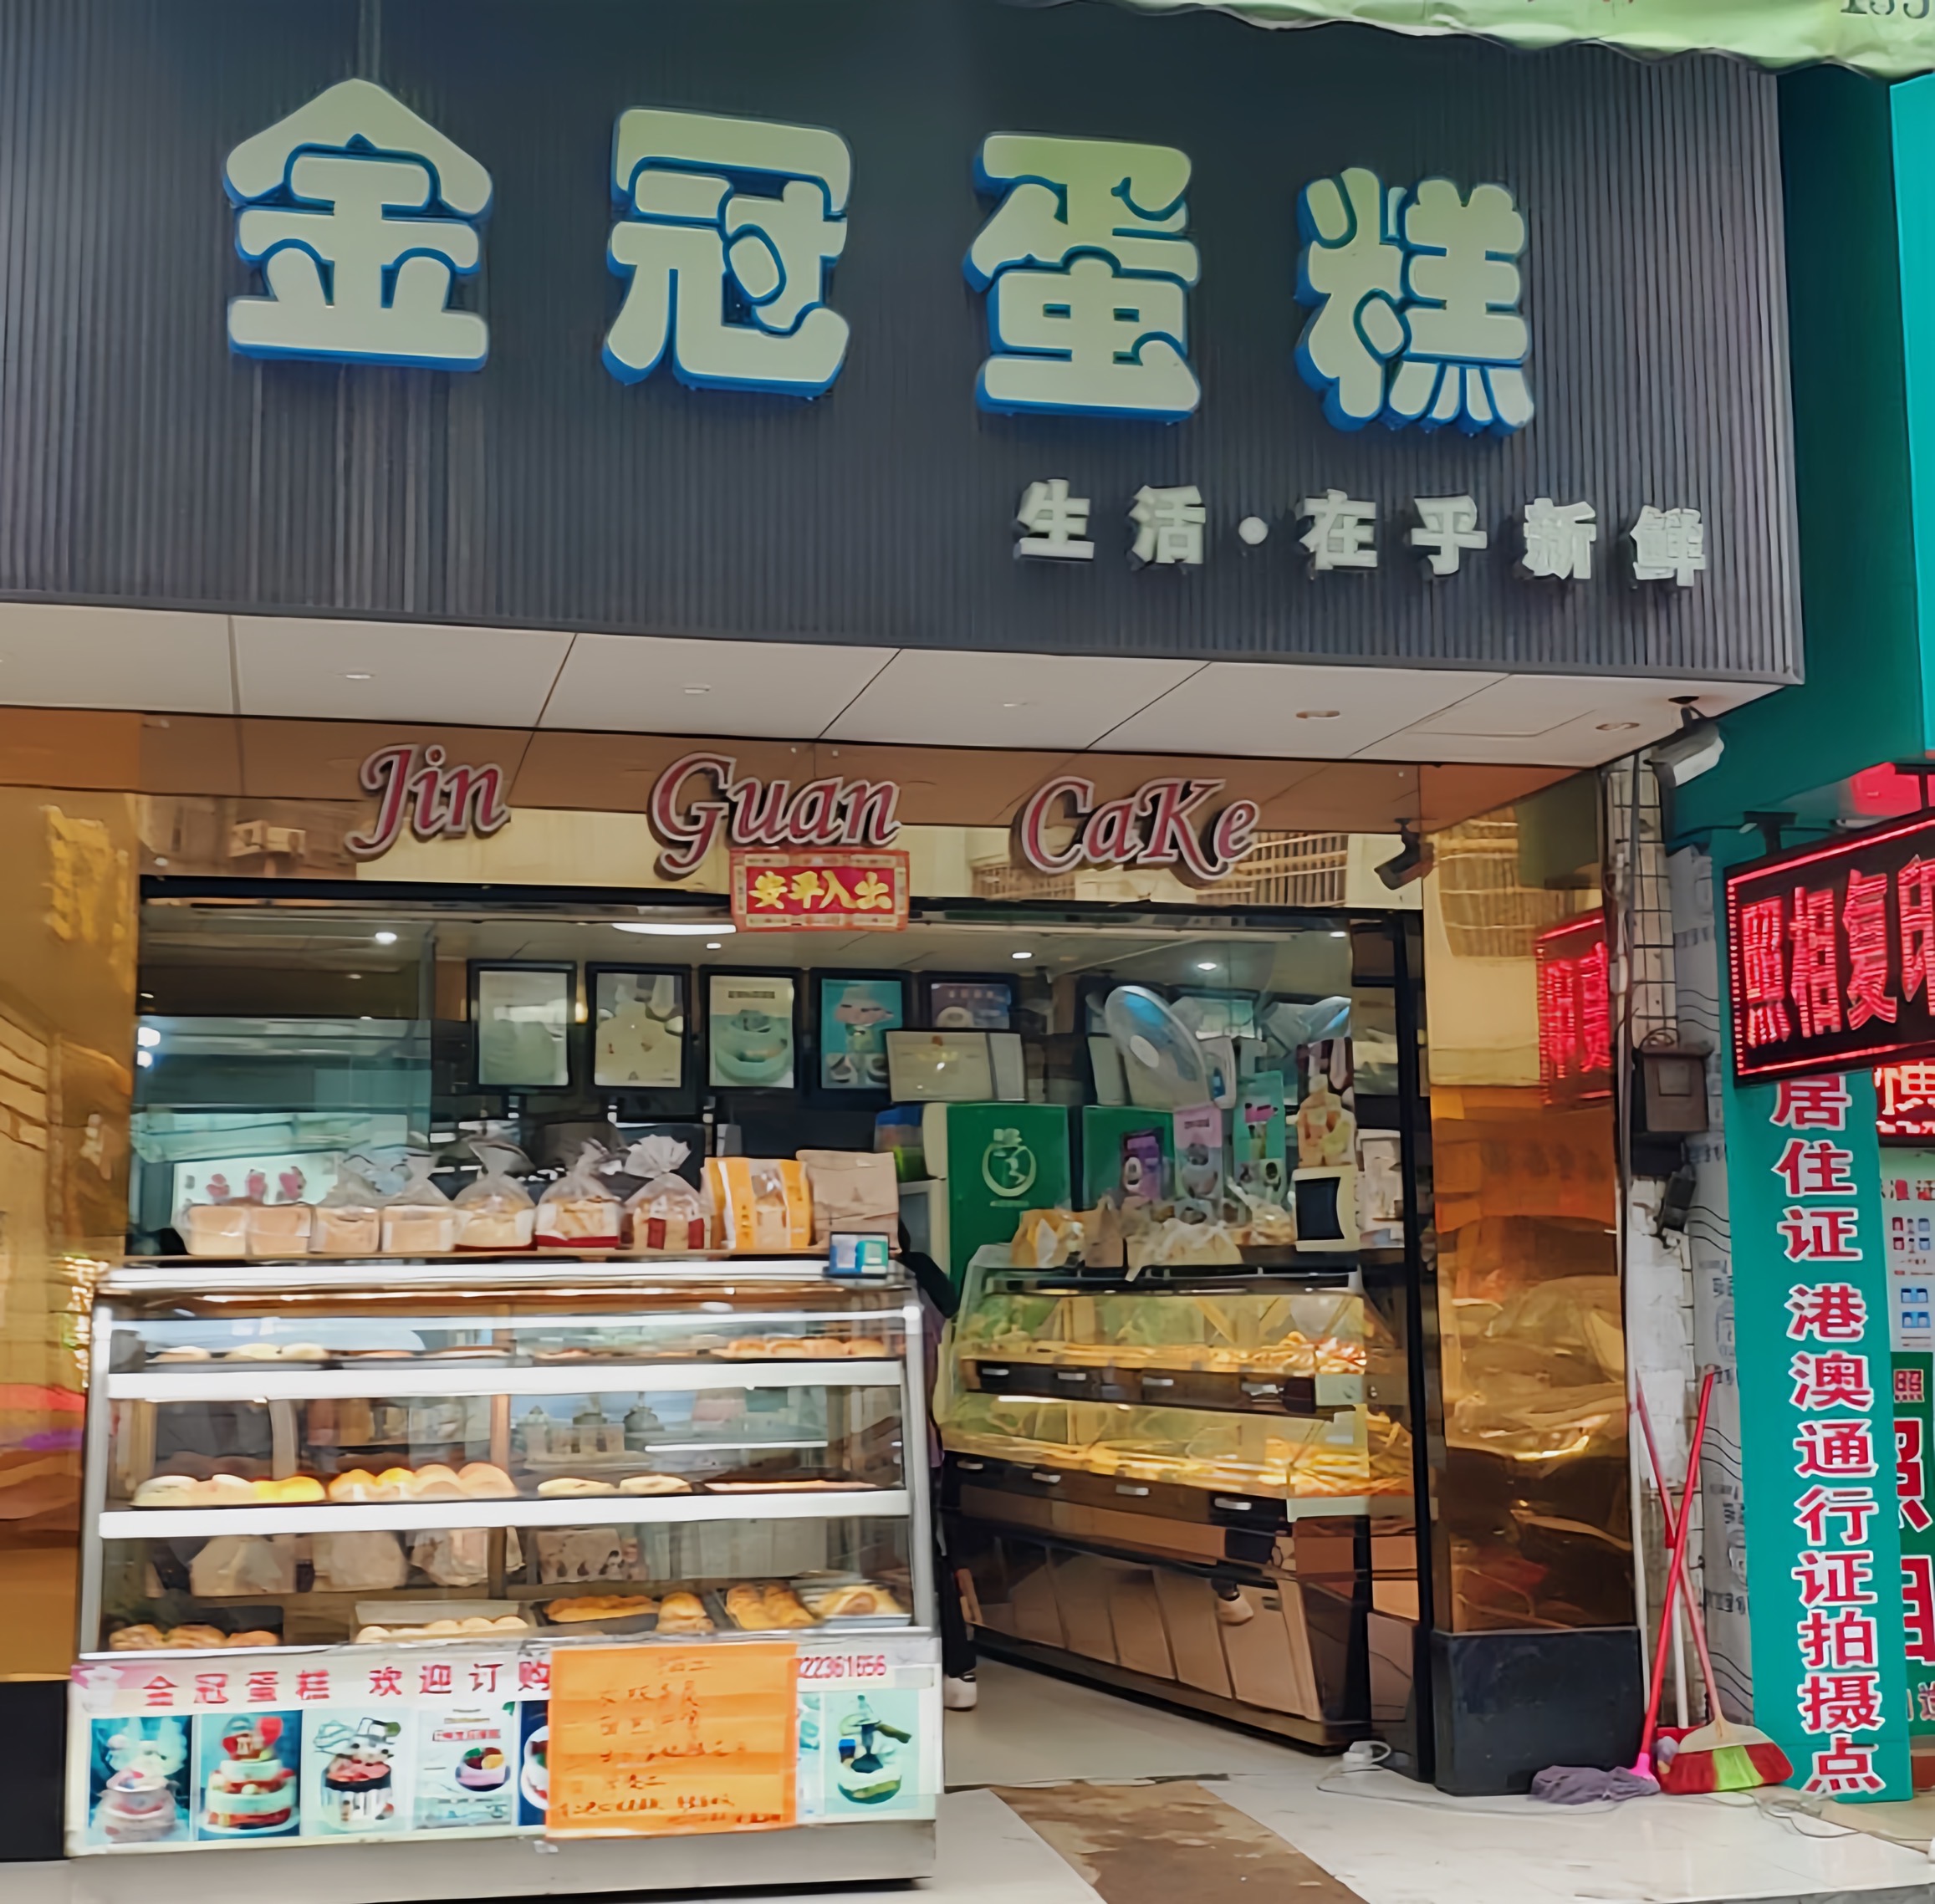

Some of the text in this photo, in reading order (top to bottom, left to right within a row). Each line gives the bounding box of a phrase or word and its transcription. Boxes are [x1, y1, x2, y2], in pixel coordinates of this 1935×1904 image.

[223, 78, 1535, 436] 金冠蛋糕
[344, 743, 513, 859] Jin
[650, 752, 902, 876] Guan
